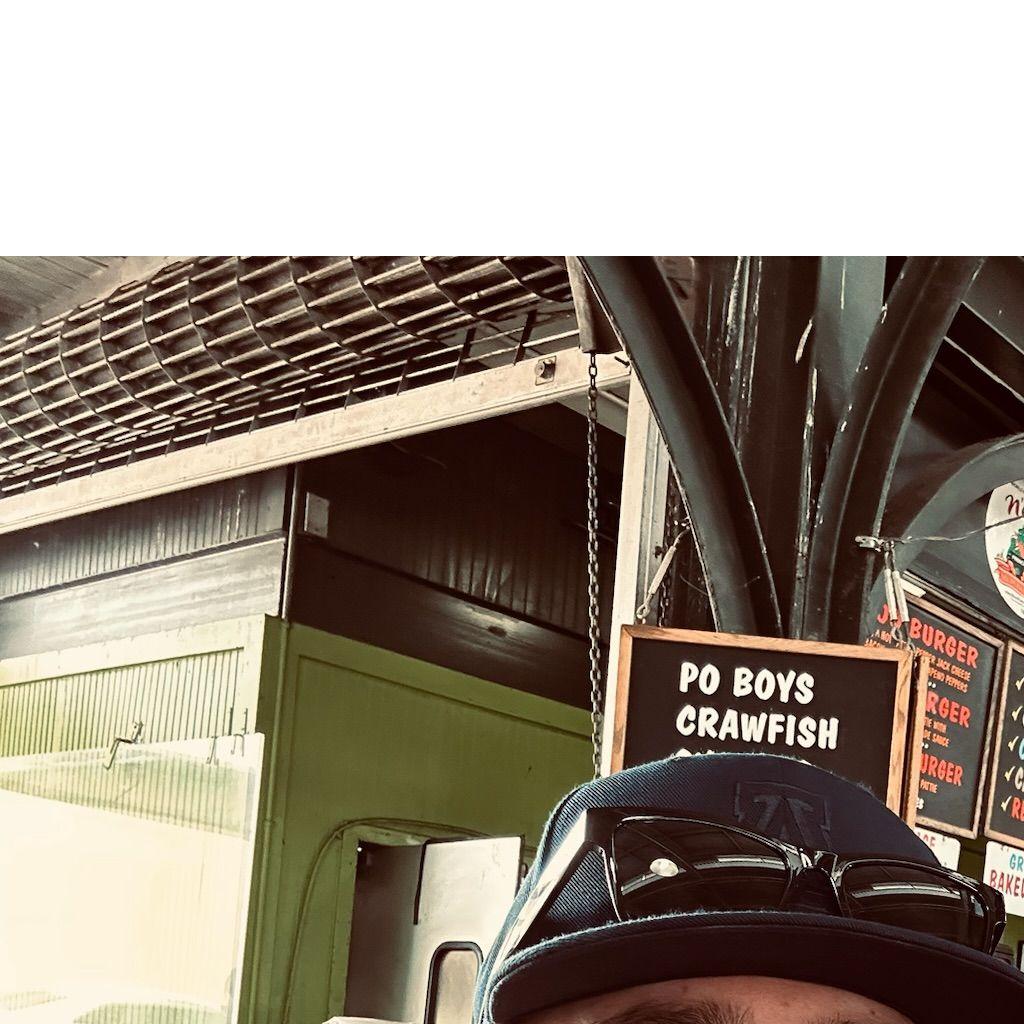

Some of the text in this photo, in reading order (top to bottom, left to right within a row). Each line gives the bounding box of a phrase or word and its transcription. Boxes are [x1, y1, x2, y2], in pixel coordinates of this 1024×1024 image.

[909, 617, 979, 669] BURGER
[678, 661, 815, 705] PO BOYS
[675, 704, 839, 750] CRAWFISH
[925, 691, 971, 728] RGER
[920, 752, 963, 787] URGER
